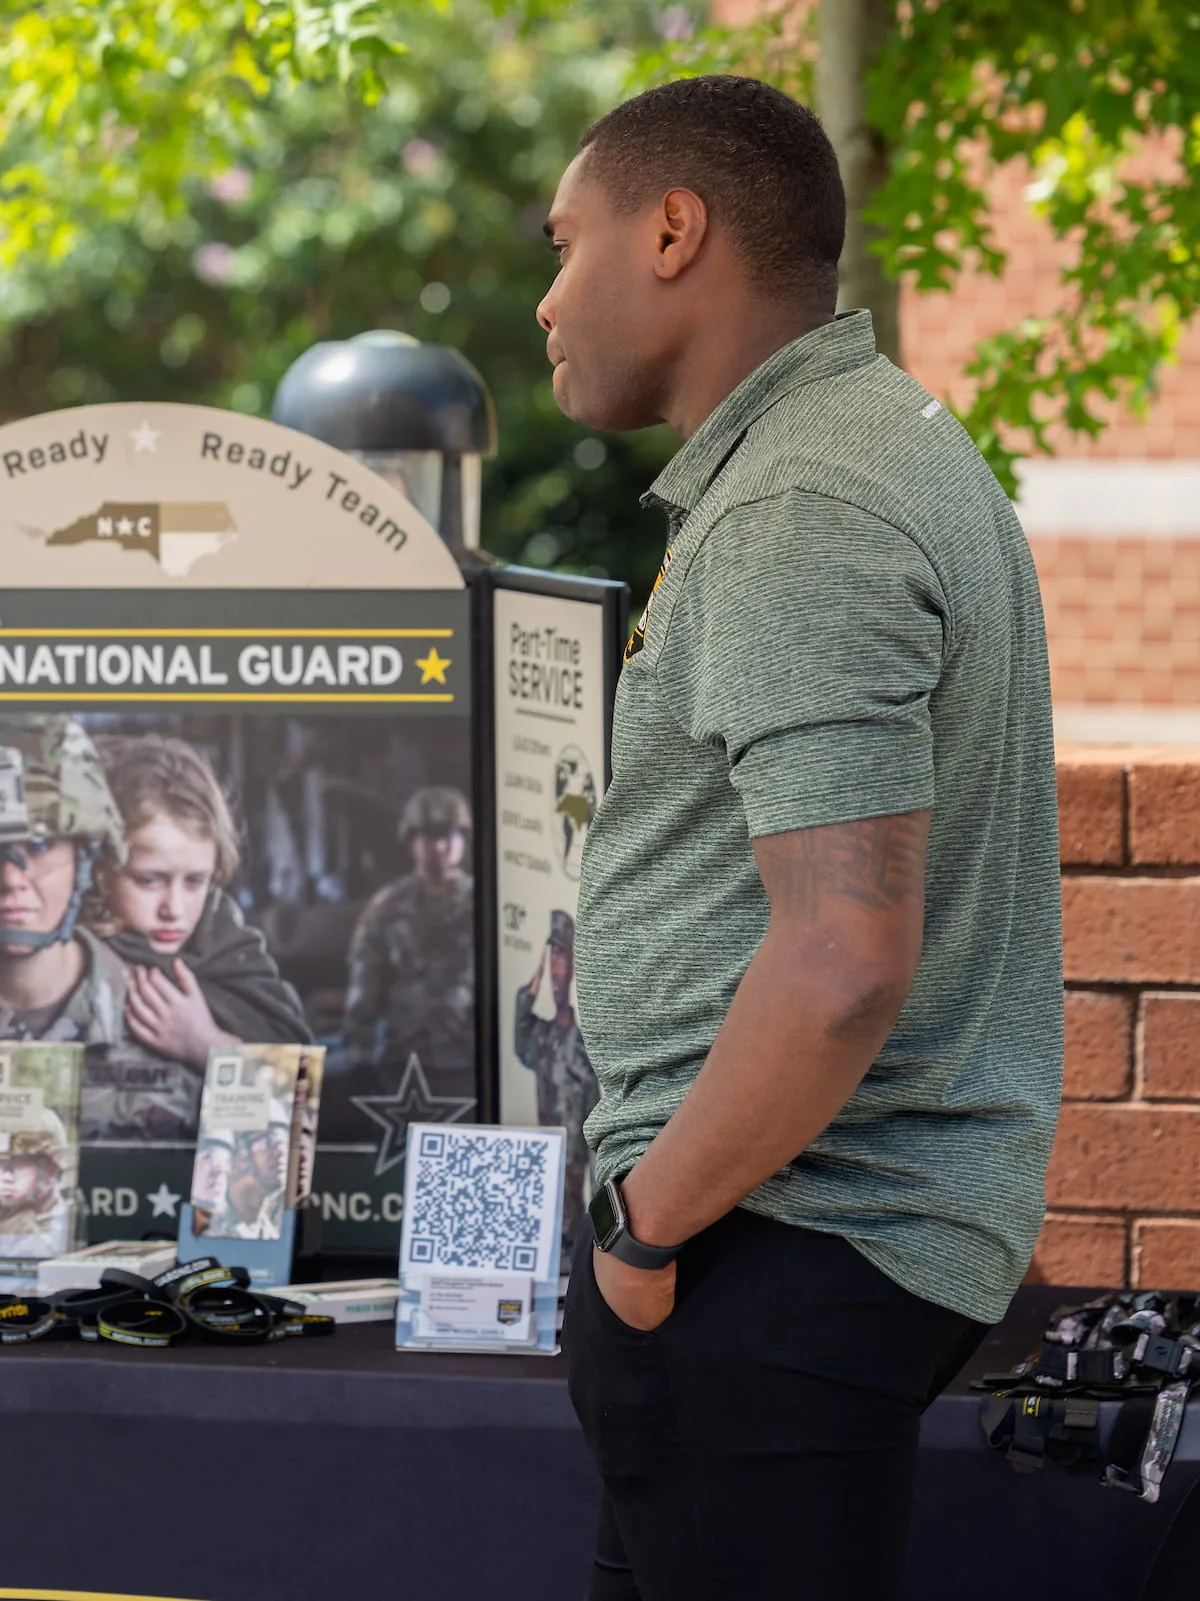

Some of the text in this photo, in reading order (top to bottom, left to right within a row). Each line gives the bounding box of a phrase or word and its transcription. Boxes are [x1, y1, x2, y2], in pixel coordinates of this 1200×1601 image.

[3, 430, 110, 480] Ready
[201, 432, 409, 552] Ready Team
[98, 519, 152, 537] N C
[238, 644, 403, 686] GUARD
[510, 621, 581, 665] Part-Time
[508, 659, 583, 709] SERVICE
[311, 1190, 403, 1222] NC.C
